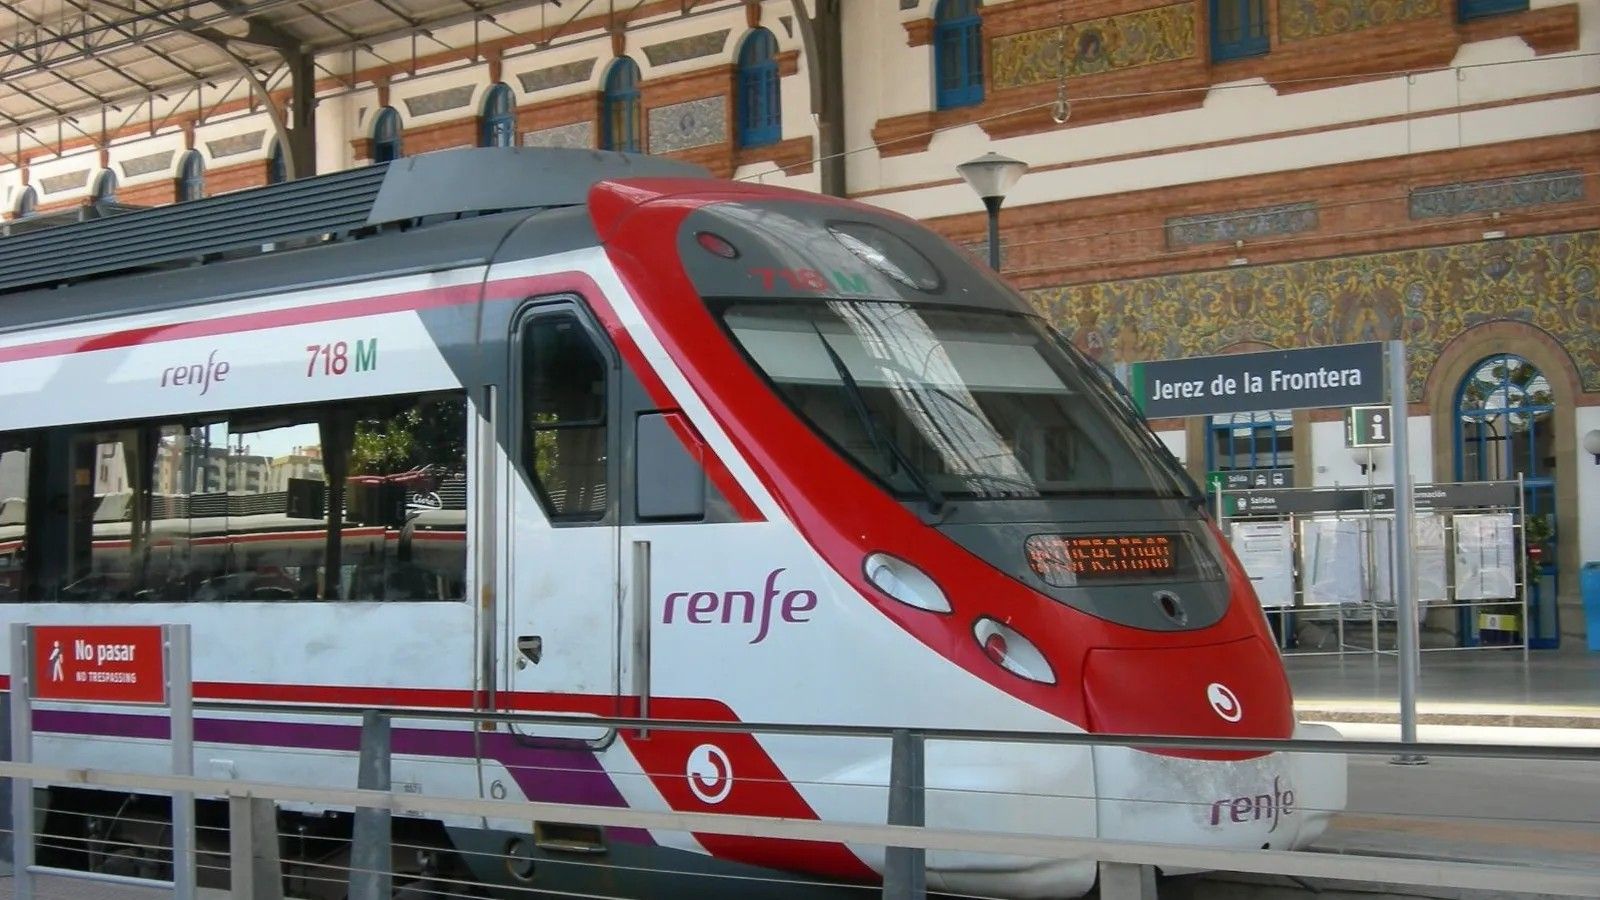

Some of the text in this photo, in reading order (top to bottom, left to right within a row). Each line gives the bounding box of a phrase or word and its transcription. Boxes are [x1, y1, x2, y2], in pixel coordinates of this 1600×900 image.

[160, 349, 230, 396] renfe
[306, 338, 378, 378] 718 M
[1152, 367, 1362, 401] Jerez de la Frontera
[1250, 496, 1276, 505] Salidas
[1413, 490, 1447, 499] ormación
[662, 567, 818, 645] renfe
[75, 639, 136, 666] No pasar
[75, 671, 137, 683] NO TRESPASSING
[1210, 775, 1294, 834] renfe
